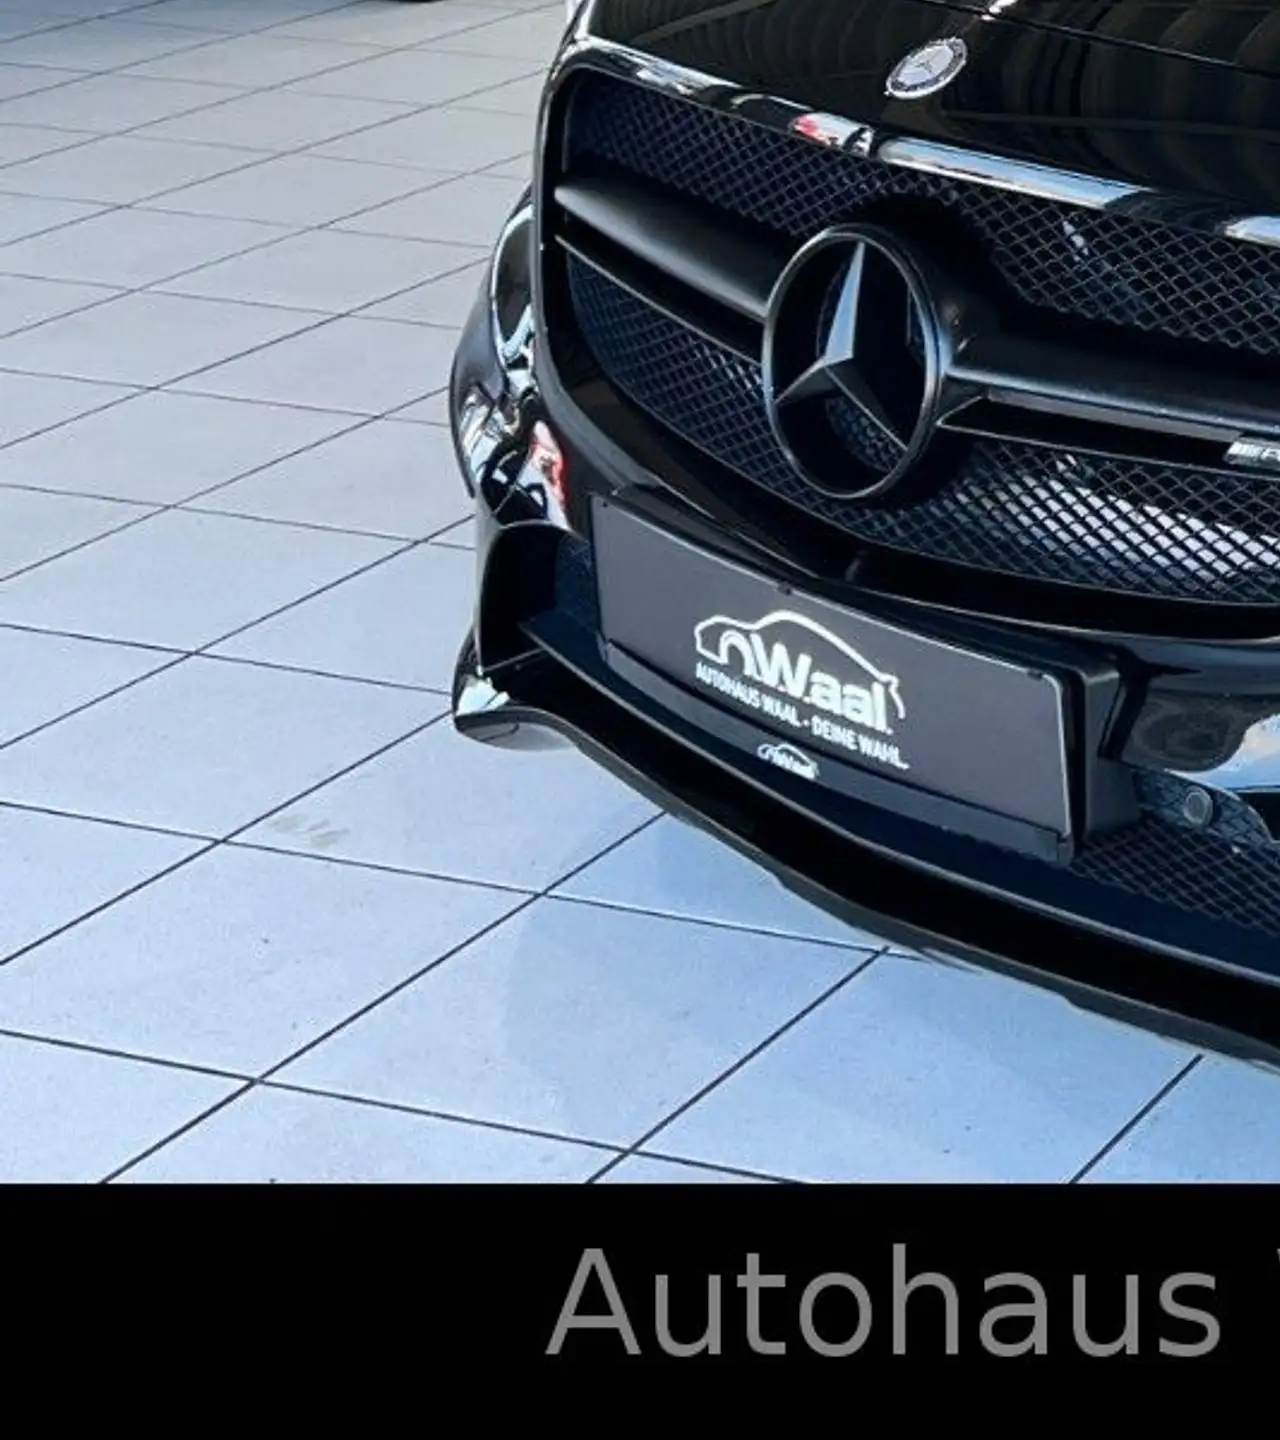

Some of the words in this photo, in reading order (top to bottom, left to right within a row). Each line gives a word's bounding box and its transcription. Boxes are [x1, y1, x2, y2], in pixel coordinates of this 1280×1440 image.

[695, 661, 761, 709] AUTOHAUS
[811, 714, 858, 750] DEINE
[749, 632, 888, 732] Waal
